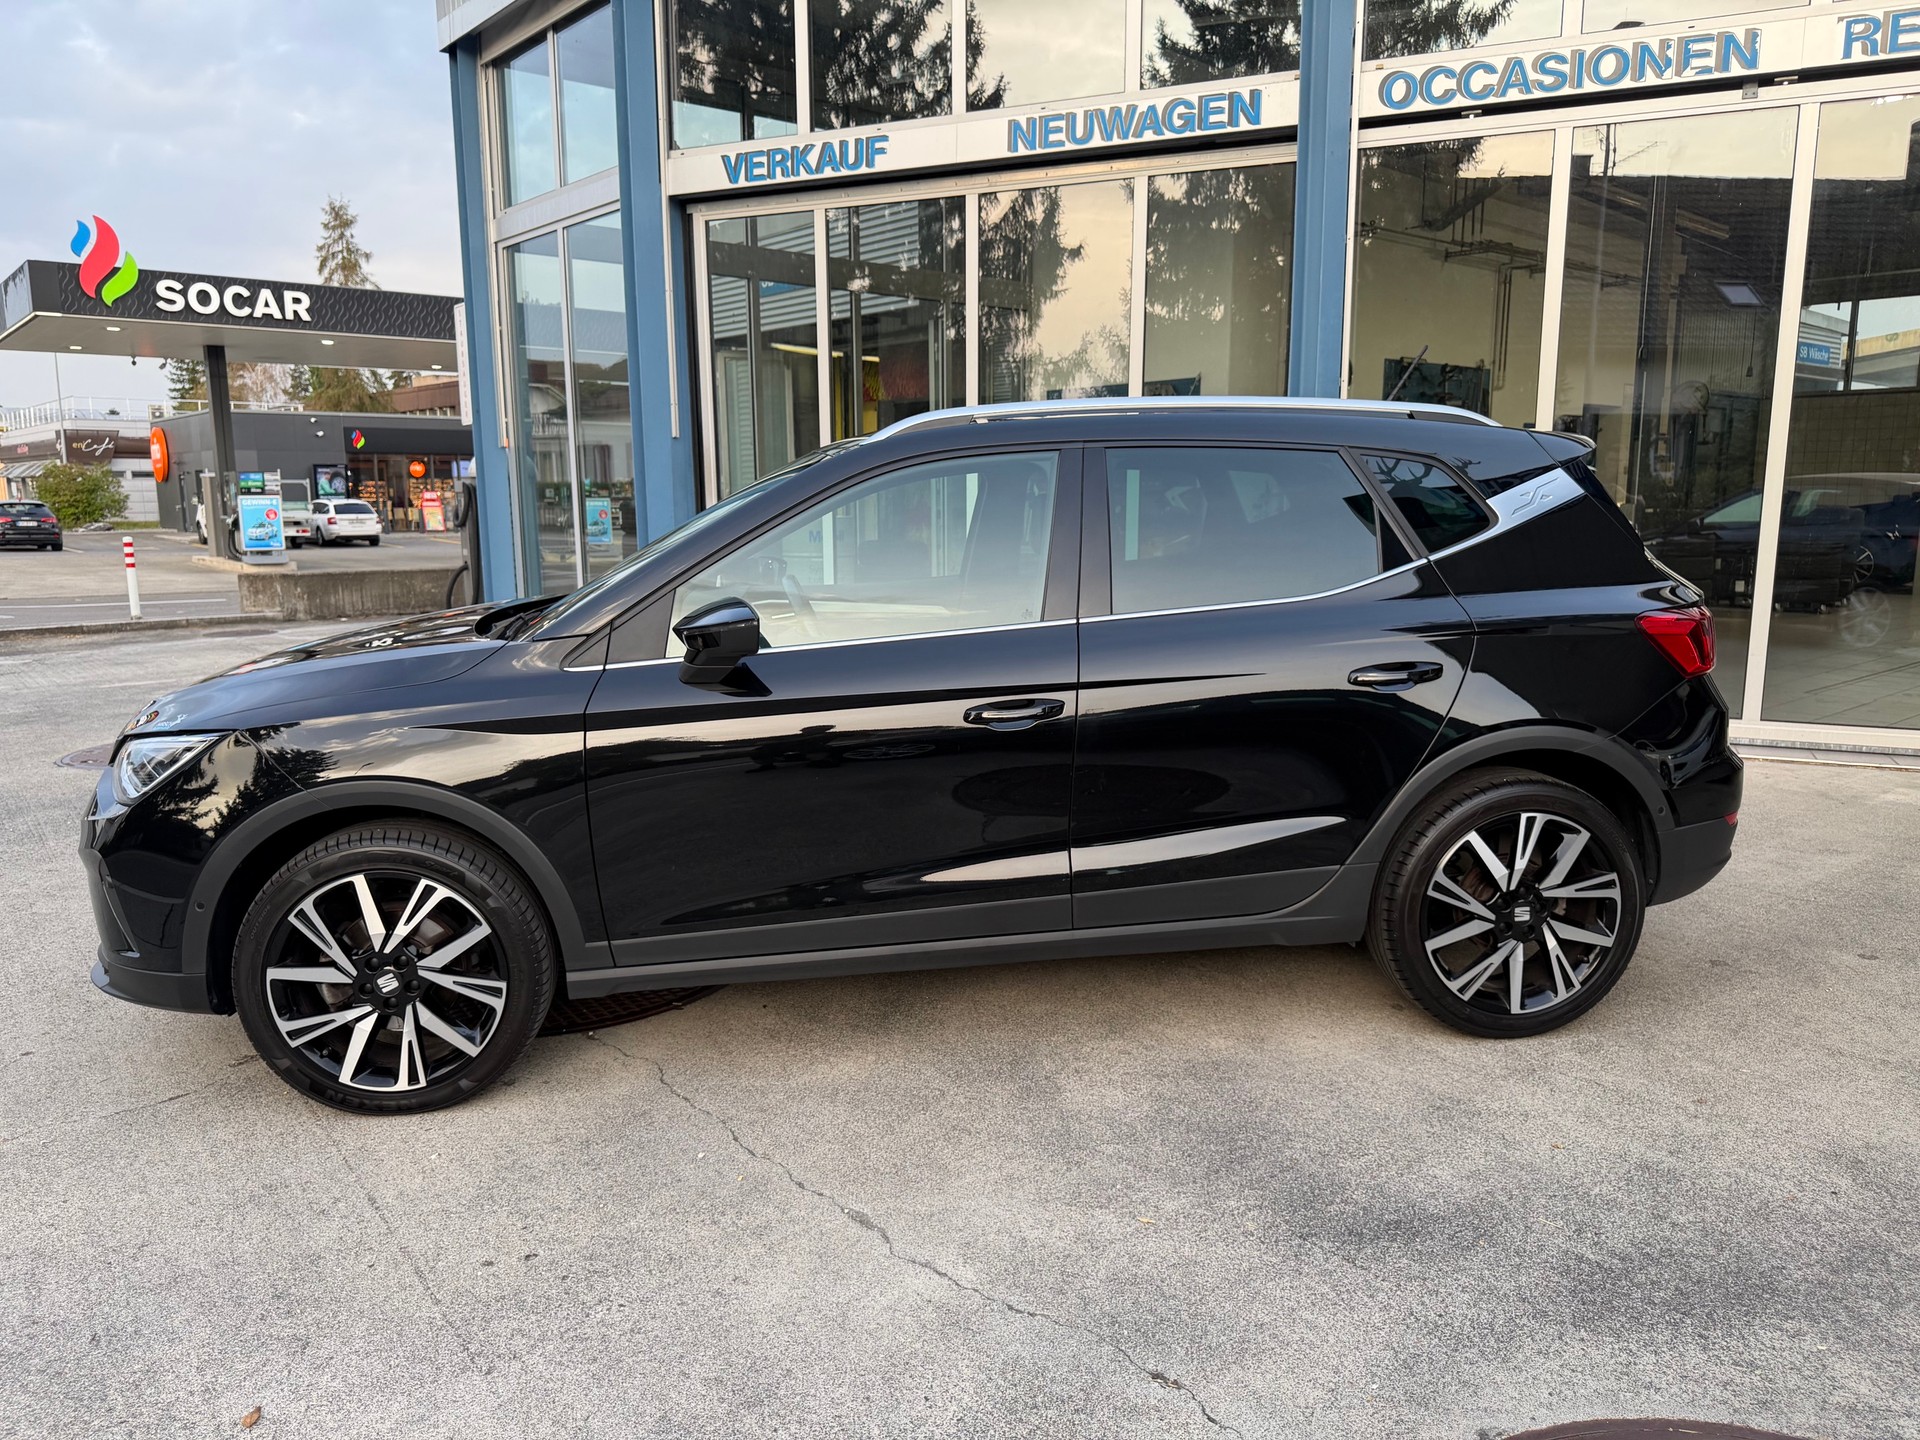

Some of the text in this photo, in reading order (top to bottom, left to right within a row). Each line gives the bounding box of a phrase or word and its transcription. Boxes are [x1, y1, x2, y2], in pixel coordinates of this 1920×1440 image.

[1378, 27, 1763, 110] OCCASIONEN
[720, 88, 1262, 185] VERKAUF NEUWAGEN
[155, 279, 312, 322] SOCAR
[1809, 347, 1829, 361] Wäsche
